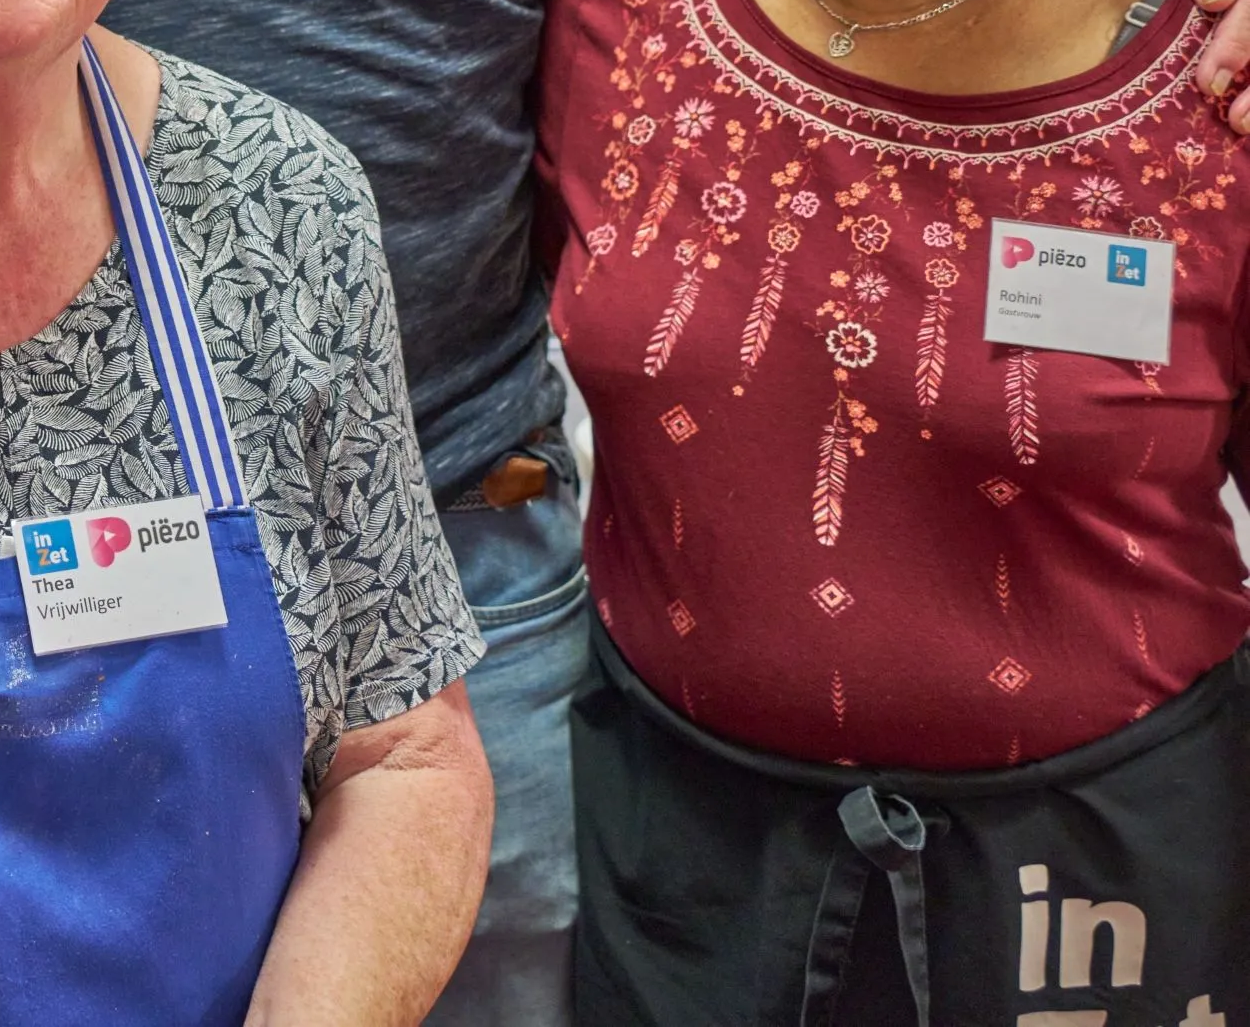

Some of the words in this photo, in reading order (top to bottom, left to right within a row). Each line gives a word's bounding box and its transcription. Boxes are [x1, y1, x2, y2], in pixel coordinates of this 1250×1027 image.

[1038, 248, 1086, 268] piëzo
[1115, 250, 1130, 266] in
[999, 289, 1043, 307] Rohini
[33, 531, 52, 548] in
[138, 518, 200, 553] piëzo
[37, 547, 70, 567] Zet
[32, 577, 75, 595] Thea
[37, 595, 123, 621] Vrijwilliger
[1018, 863, 1147, 993] in
